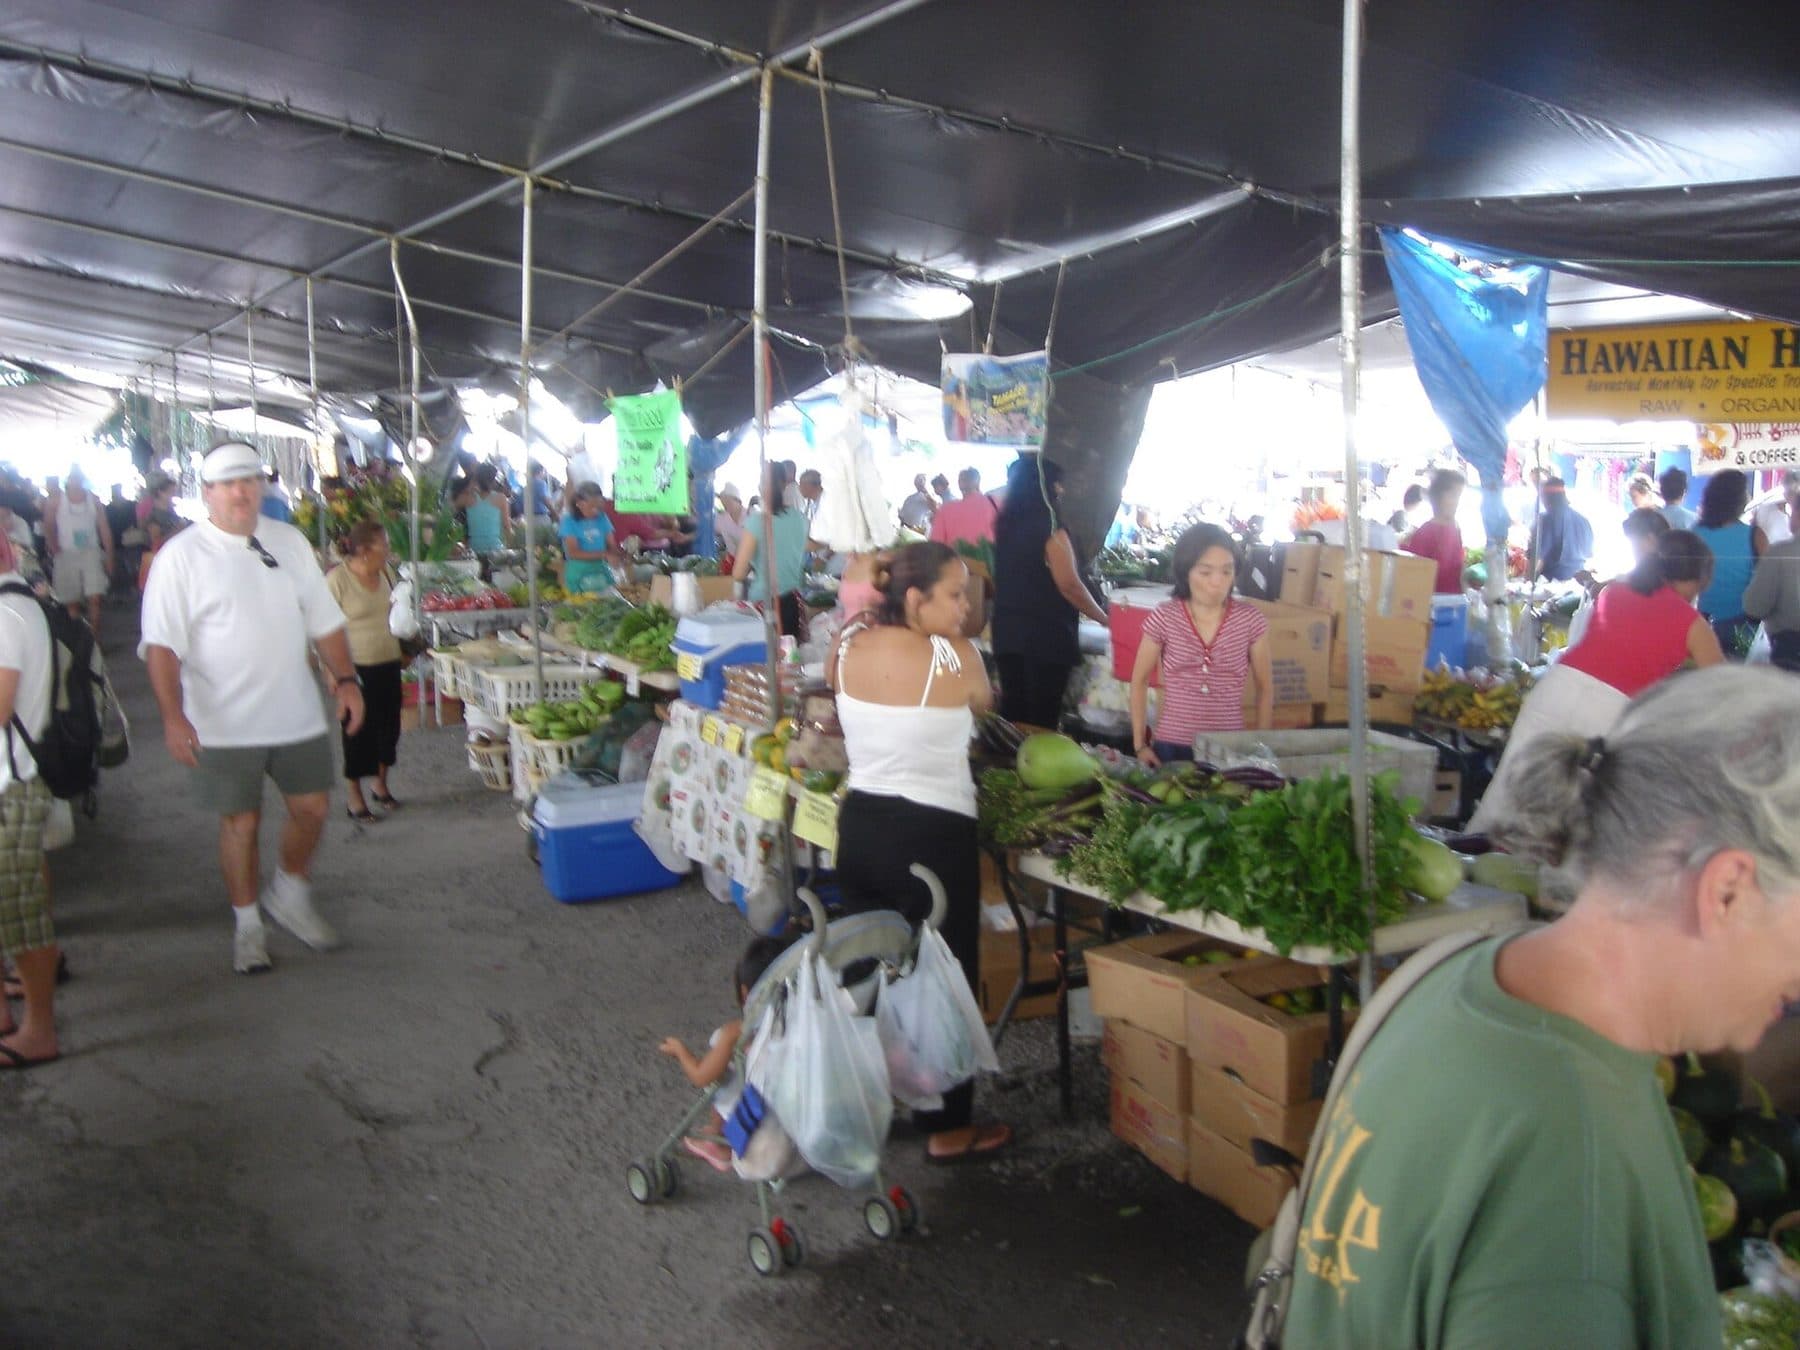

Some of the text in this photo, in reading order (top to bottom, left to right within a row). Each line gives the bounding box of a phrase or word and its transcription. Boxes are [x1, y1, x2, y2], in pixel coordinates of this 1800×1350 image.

[1561, 335, 1749, 375] HAWAIIAN
[1640, 399, 1681, 414] RAW
[1749, 447, 1796, 465] COFFEE
